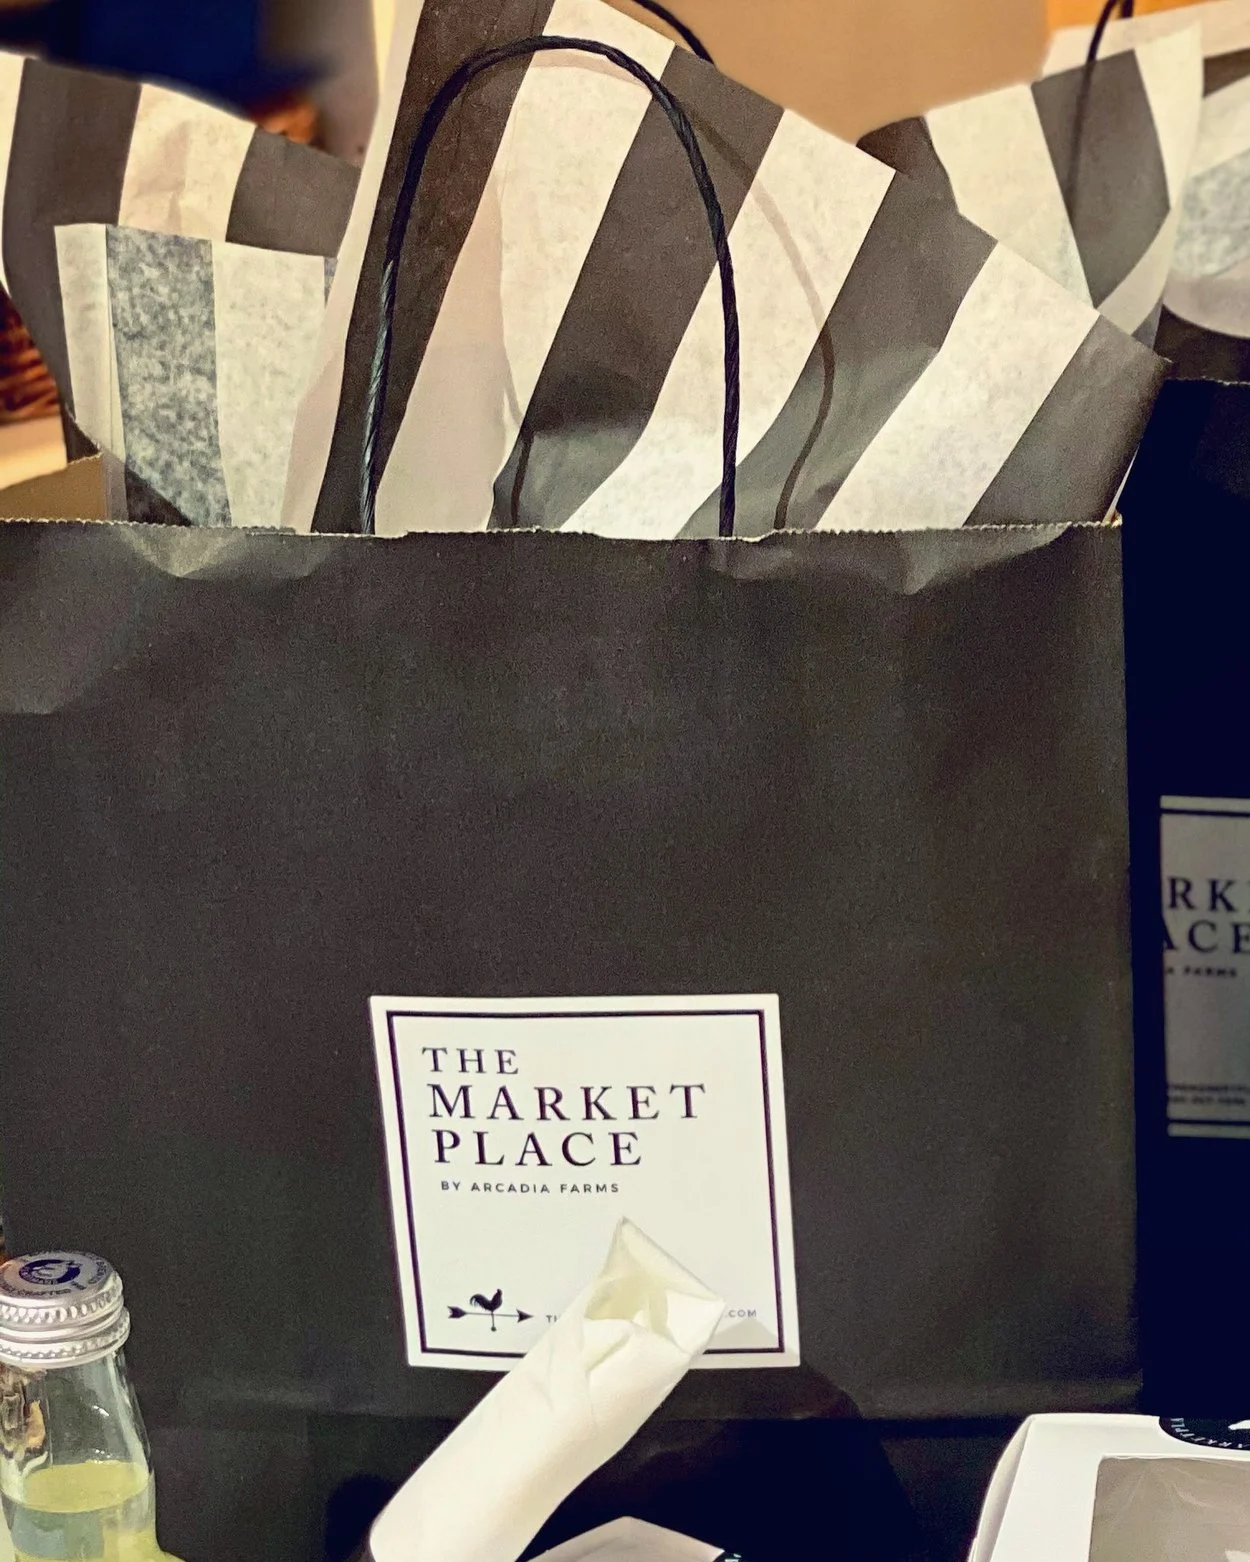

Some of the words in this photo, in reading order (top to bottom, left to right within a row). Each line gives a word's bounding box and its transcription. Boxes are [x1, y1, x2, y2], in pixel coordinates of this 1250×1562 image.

[422, 1046, 519, 1075] THE
[427, 1083, 706, 1121] MARKET
[431, 1129, 642, 1167] PLACE
[441, 1180, 461, 1192] BY
[470, 1182, 550, 1194] ARCADIA
[560, 1183, 620, 1194] FARMS
